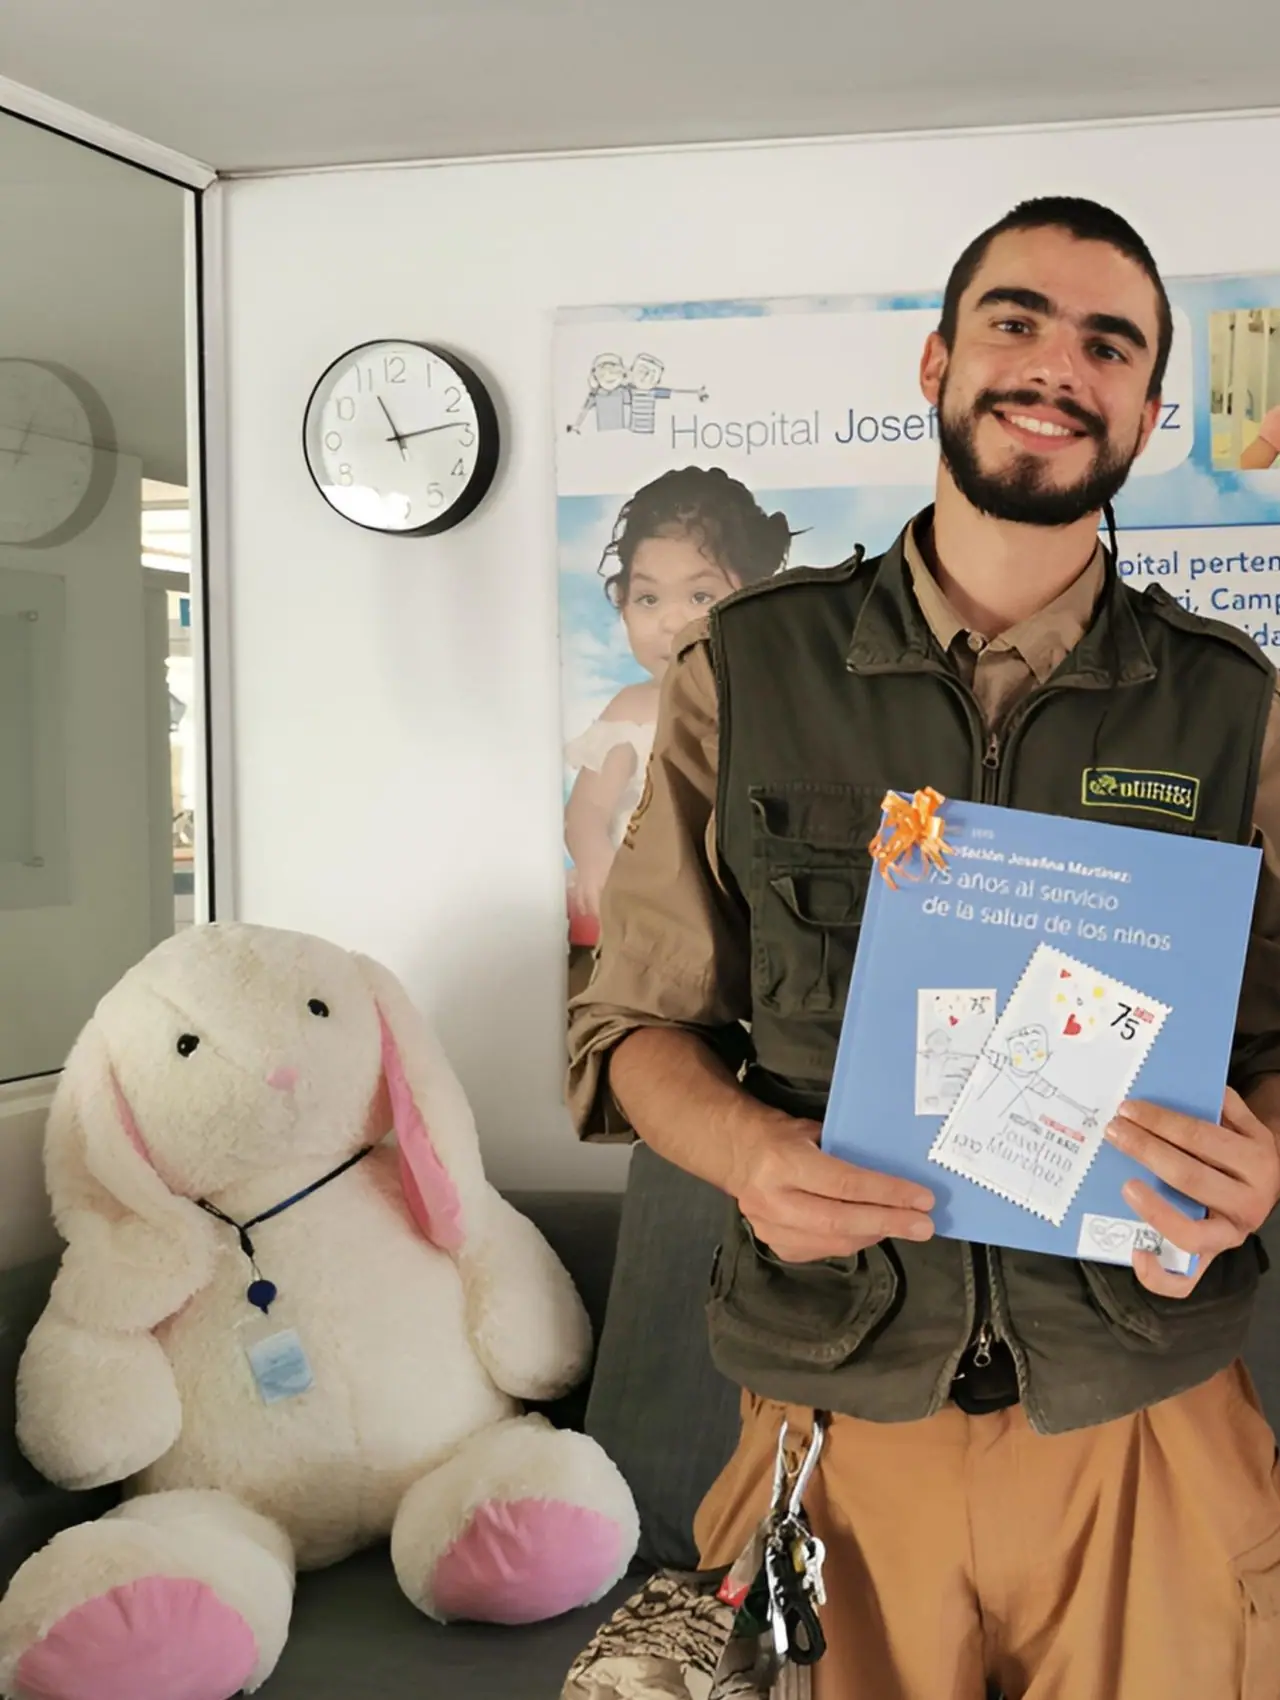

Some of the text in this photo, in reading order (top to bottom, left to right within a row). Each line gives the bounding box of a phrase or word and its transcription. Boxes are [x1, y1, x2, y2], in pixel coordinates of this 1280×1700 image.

[444, 386, 462, 413] 2
[671, 409, 819, 455] Hospital
[957, 871, 1010, 895] años
[1015, 878, 1034, 898] al
[1040, 884, 1119, 911] servicio
[922, 895, 1172, 952] de la salud de los niños
